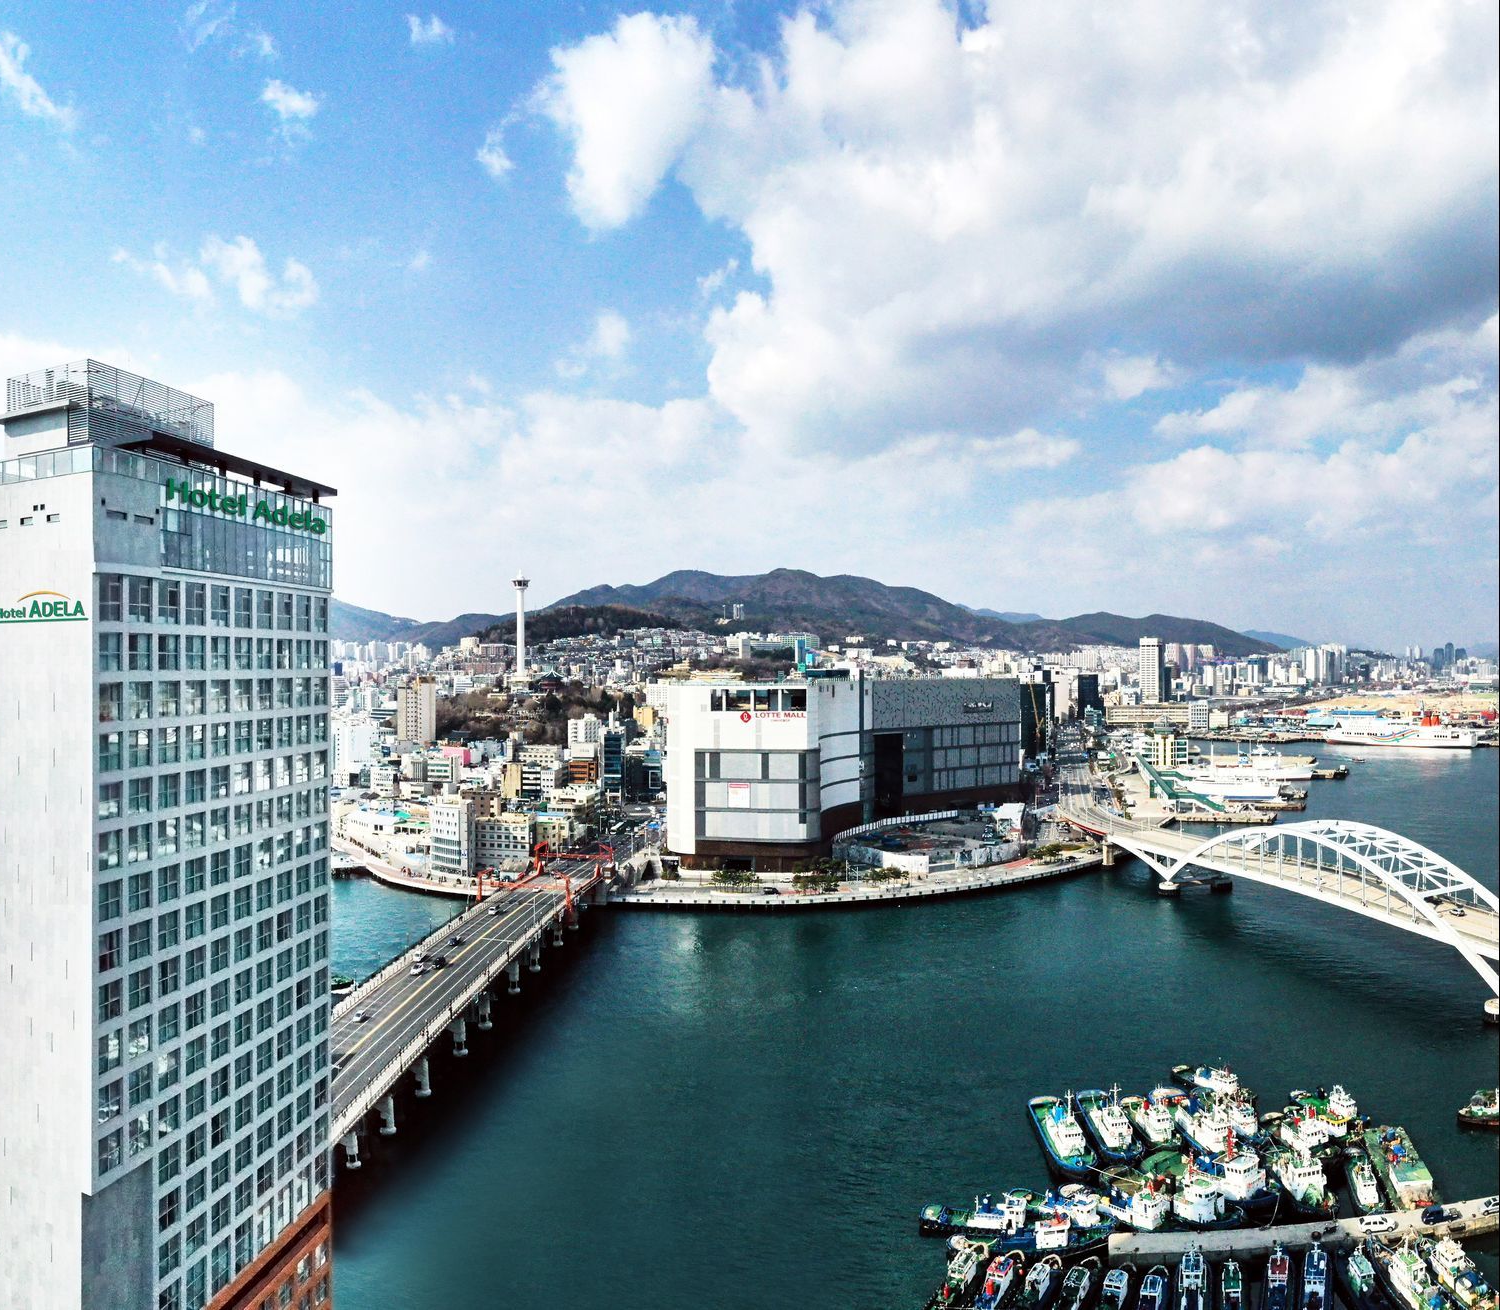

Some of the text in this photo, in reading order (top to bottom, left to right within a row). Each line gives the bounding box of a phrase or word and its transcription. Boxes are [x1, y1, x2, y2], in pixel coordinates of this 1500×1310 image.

[166, 477, 326, 535] Hotel Adela
[29, 600, 85, 618] ADELA
